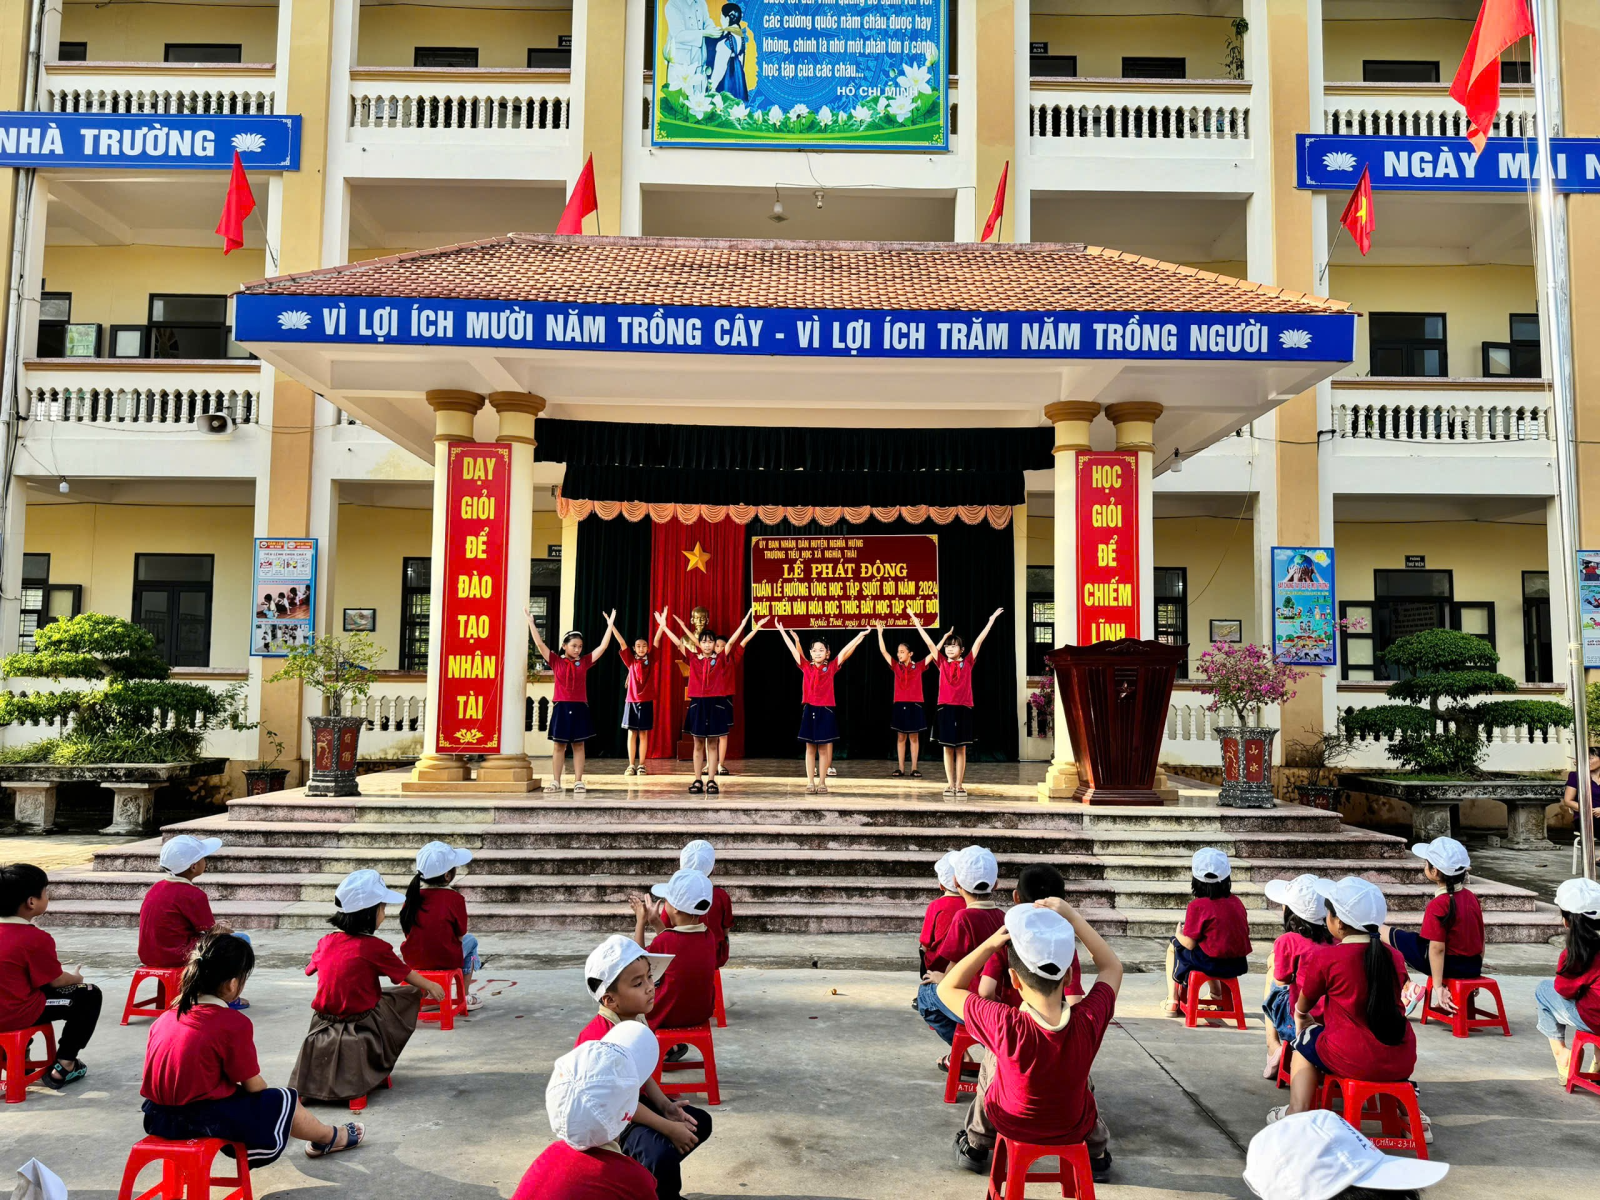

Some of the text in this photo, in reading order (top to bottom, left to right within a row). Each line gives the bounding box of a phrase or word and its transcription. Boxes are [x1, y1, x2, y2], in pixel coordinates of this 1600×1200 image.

[764, 11, 931, 32] các cường quốc năm châu được hay
[763, 37, 790, 54] không,
[793, 37, 816, 52] chính
[820, 37, 827, 52] là
[830, 36, 845, 52] nhờ
[847, 38, 863, 56] một
[866, 35, 886, 55] phần
[888, 38, 901, 53] lớn
[904, 36, 909, 53] ở
[763, 60, 864, 80] học tập của các cháu...
[837, 83, 855, 96] HỒ
[860, 85, 880, 96] CHÍ
[0, 122, 215, 156] NHÀ TRƯỜNG
[1384, 146, 1479, 179] NGÀY
[323, 303, 346, 335] VÌ
[359, 306, 398, 342] LỢI
[411, 304, 453, 338] ÍCH
[466, 306, 533, 341] MƯỜI
[546, 309, 606, 343] NĂM
[618, 308, 702, 345] TRỒNG
[714, 313, 763, 347] CÂY
[797, 315, 820, 348] VÌ
[833, 319, 871, 354] LỢI
[883, 317, 925, 349] ÍCH
[937, 317, 1008, 350] TRĂM
[1021, 317, 1080, 350] NĂM
[1093, 315, 1177, 351] TRỒNG
[1190, 319, 1268, 353] NGƯỜI
[463, 458, 496, 485] DẠY
[1092, 465, 1121, 493] HỌC
[461, 489, 495, 519] GIỎI
[1092, 497, 1122, 527] GIỎI
[466, 527, 489, 558] ĐỂ
[764, 548, 857, 560] TRƯỜNG TIỂU HỌC XÃ NGHĨA THÁI
[781, 538, 795, 548] NHÂN
[798, 538, 809, 547] DÂN
[811, 538, 827, 549] HUYỆN
[830, 538, 845, 547] NGHĨA
[848, 539, 863, 547] HƯNG
[1098, 535, 1117, 566] ĐỂ
[783, 558, 907, 579] LỄ PHÁT ĐỘNG
[458, 571, 492, 598] ĐÀO
[774, 579, 782, 596] LỄ
[784, 579, 808, 596] HƯỞNG
[811, 579, 826, 596] ỨNG
[829, 582, 843, 598] HỌC
[846, 580, 860, 598] TẬP
[862, 578, 880, 595] SUỐT
[883, 578, 895, 595] ĐỜI
[898, 579, 915, 595] NĂM
[919, 581, 938, 595] 2024
[1084, 577, 1131, 606] CHIẾM
[753, 596, 938, 616] PHÁT TRIỂN VĂN HÓA ĐỌC THÚC ĐẨY HỌC TẬP SUỐT ĐỜI
[458, 615, 489, 643] TẠO
[1092, 618, 1125, 644] LĨNH
[448, 651, 496, 678] NHÂN
[457, 691, 483, 719] TÀI
